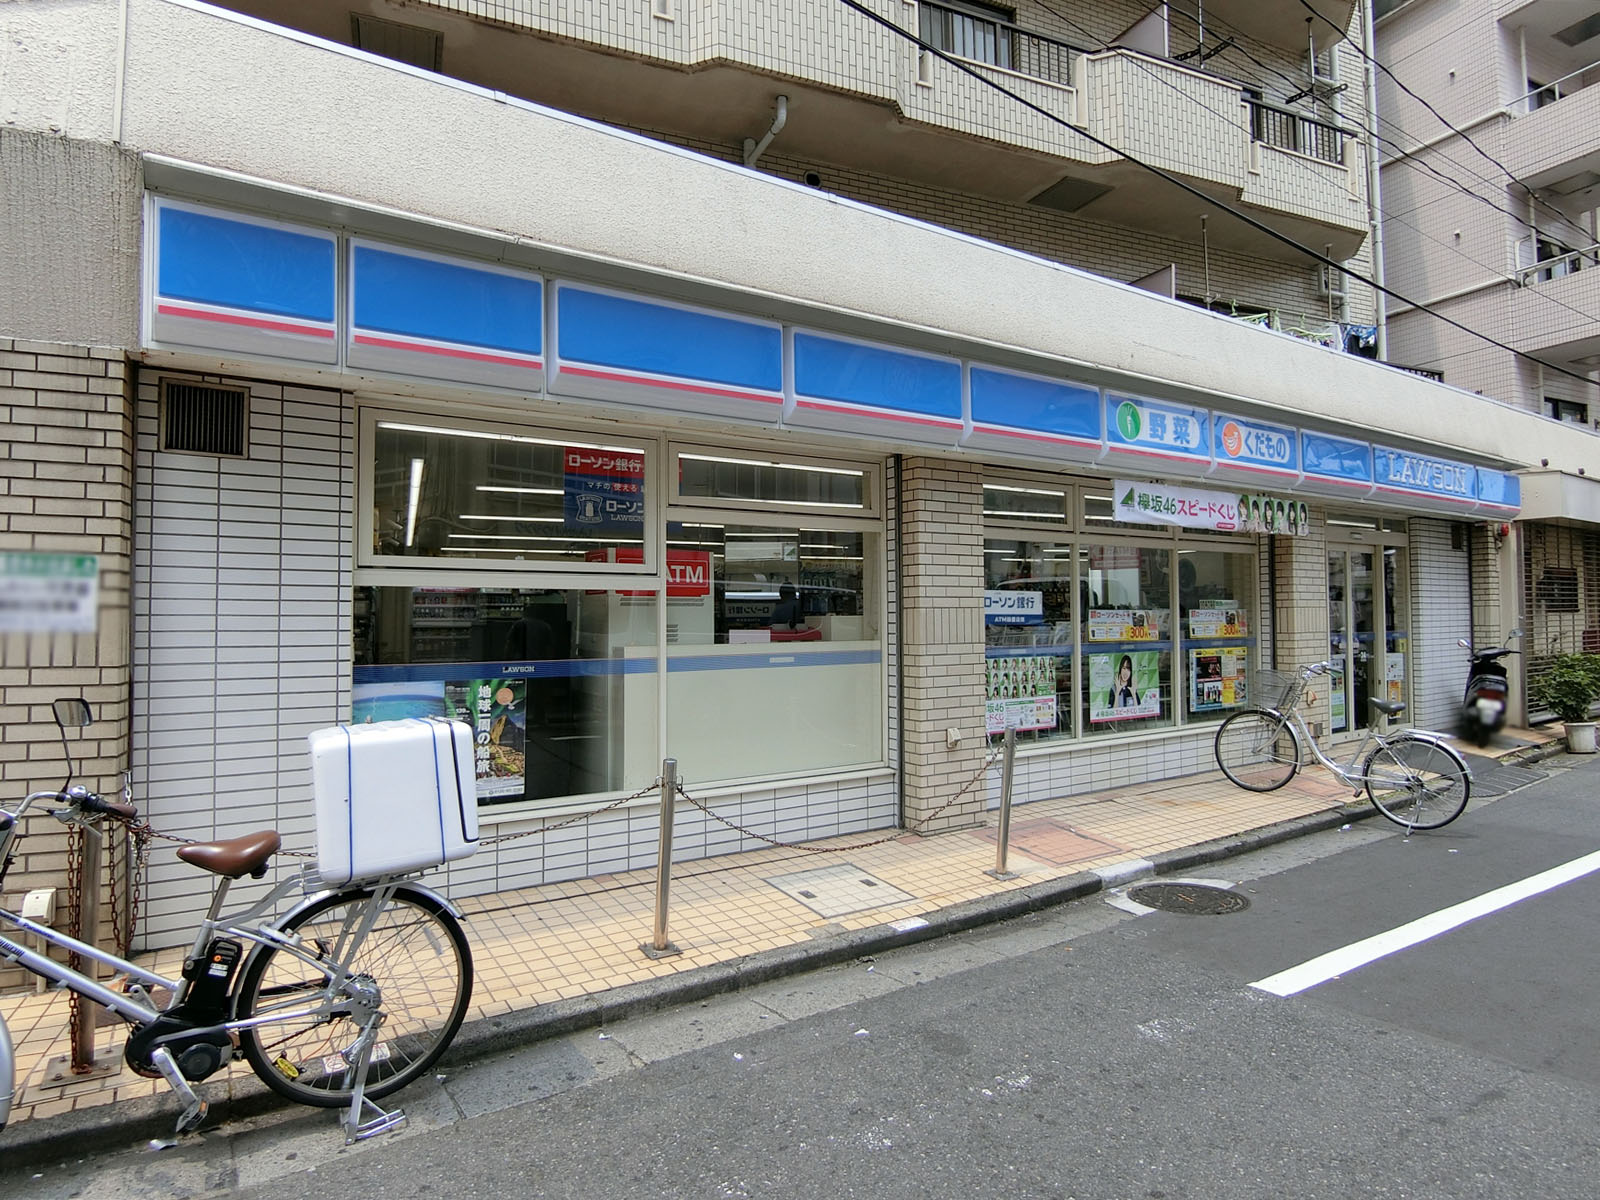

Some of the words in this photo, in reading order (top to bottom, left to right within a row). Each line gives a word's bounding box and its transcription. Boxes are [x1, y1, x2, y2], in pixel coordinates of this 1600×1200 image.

[1149, 411, 1191, 445] 野菜
[1244, 431, 1286, 460] くだもの
[568, 454, 645, 473] ローソン銀行
[1387, 453, 1467, 495] LAWSON
[984, 596, 1035, 609] ローソン銀行
[502, 665, 536, 673] LAWSON
[476, 684, 492, 773] 地球一周の船旅
